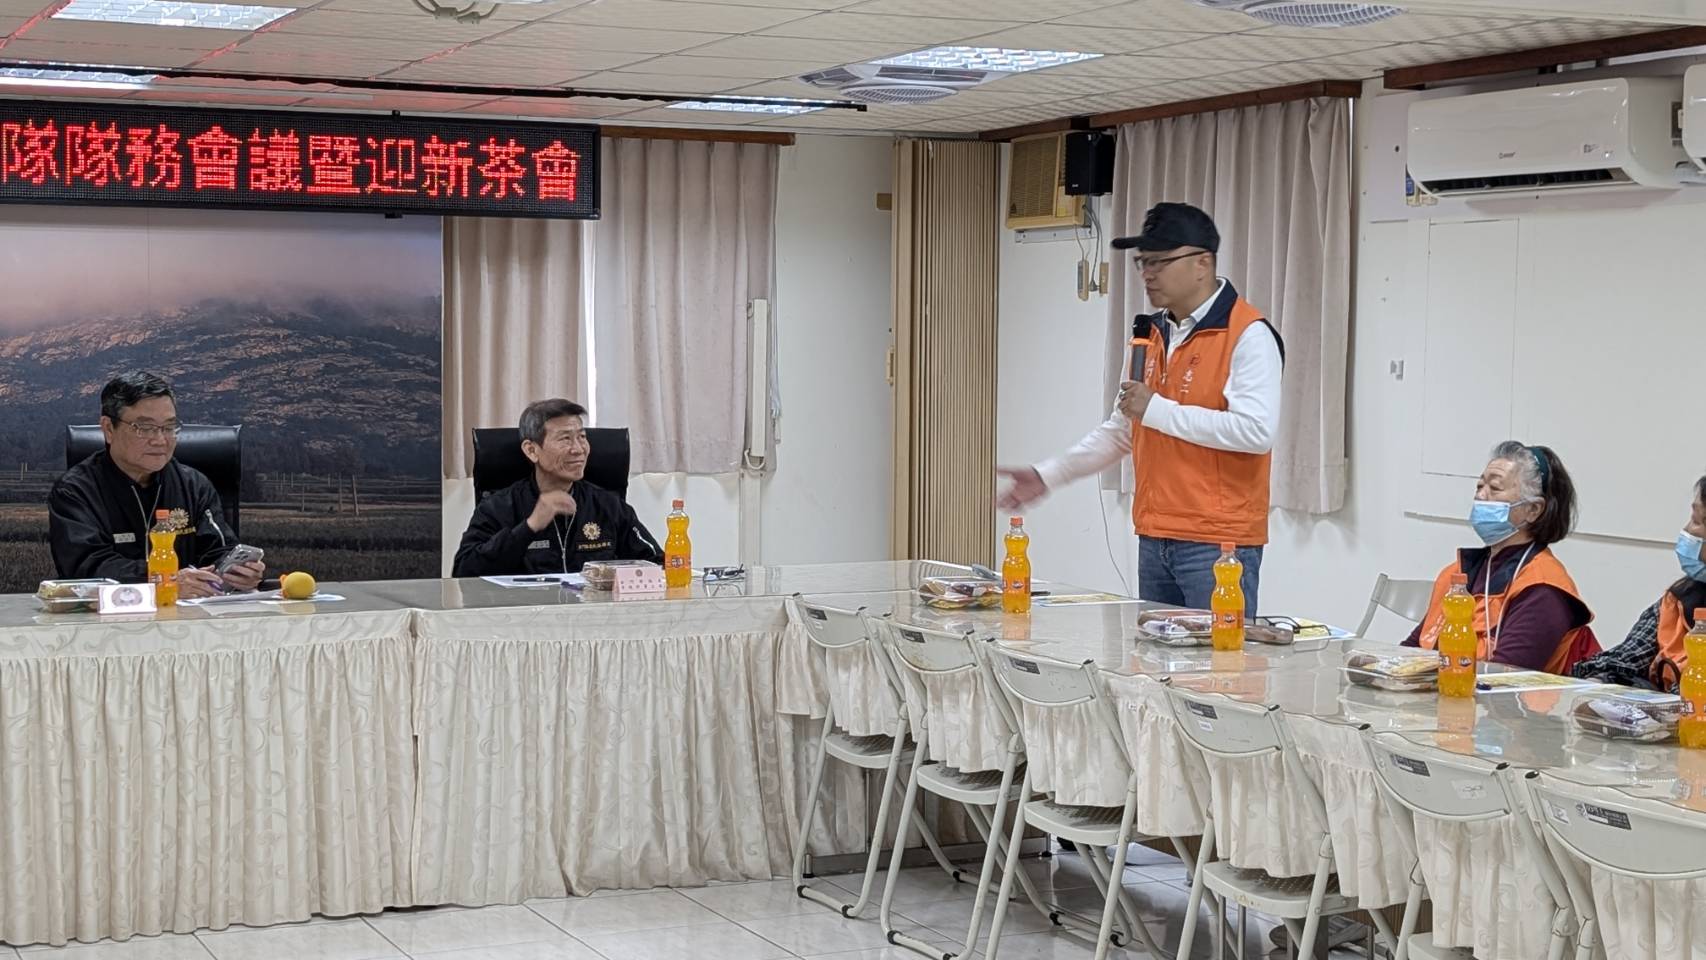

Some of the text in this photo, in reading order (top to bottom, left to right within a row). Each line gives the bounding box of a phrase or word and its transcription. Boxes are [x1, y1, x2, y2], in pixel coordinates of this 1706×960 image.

[2, 119, 581, 201] 隊隊務會議暨迎新茶會
